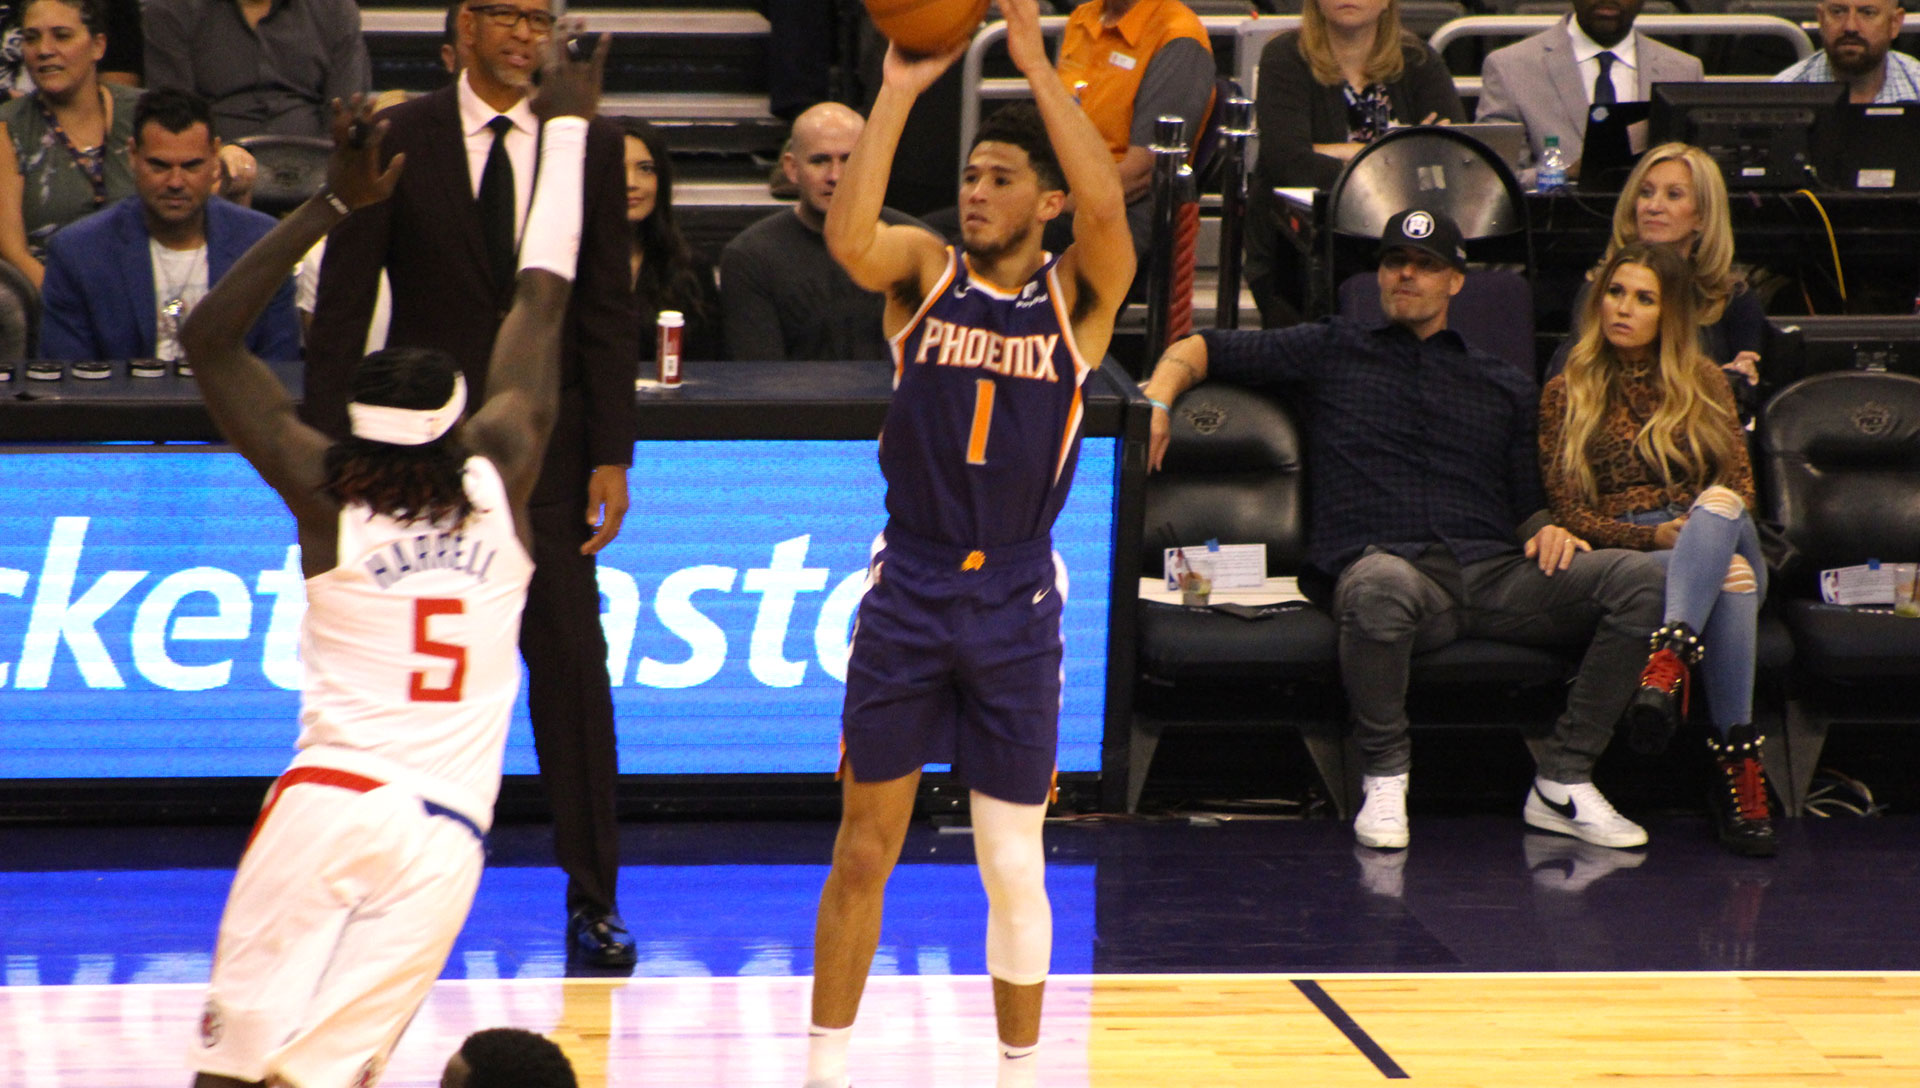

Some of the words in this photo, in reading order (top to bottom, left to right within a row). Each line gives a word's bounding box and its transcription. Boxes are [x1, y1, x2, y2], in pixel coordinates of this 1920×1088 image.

[915, 315, 1060, 383] PHOENIX
[966, 378, 996, 465] 1
[364, 532, 497, 591] HARRELL
[408, 597, 469, 703] 5
